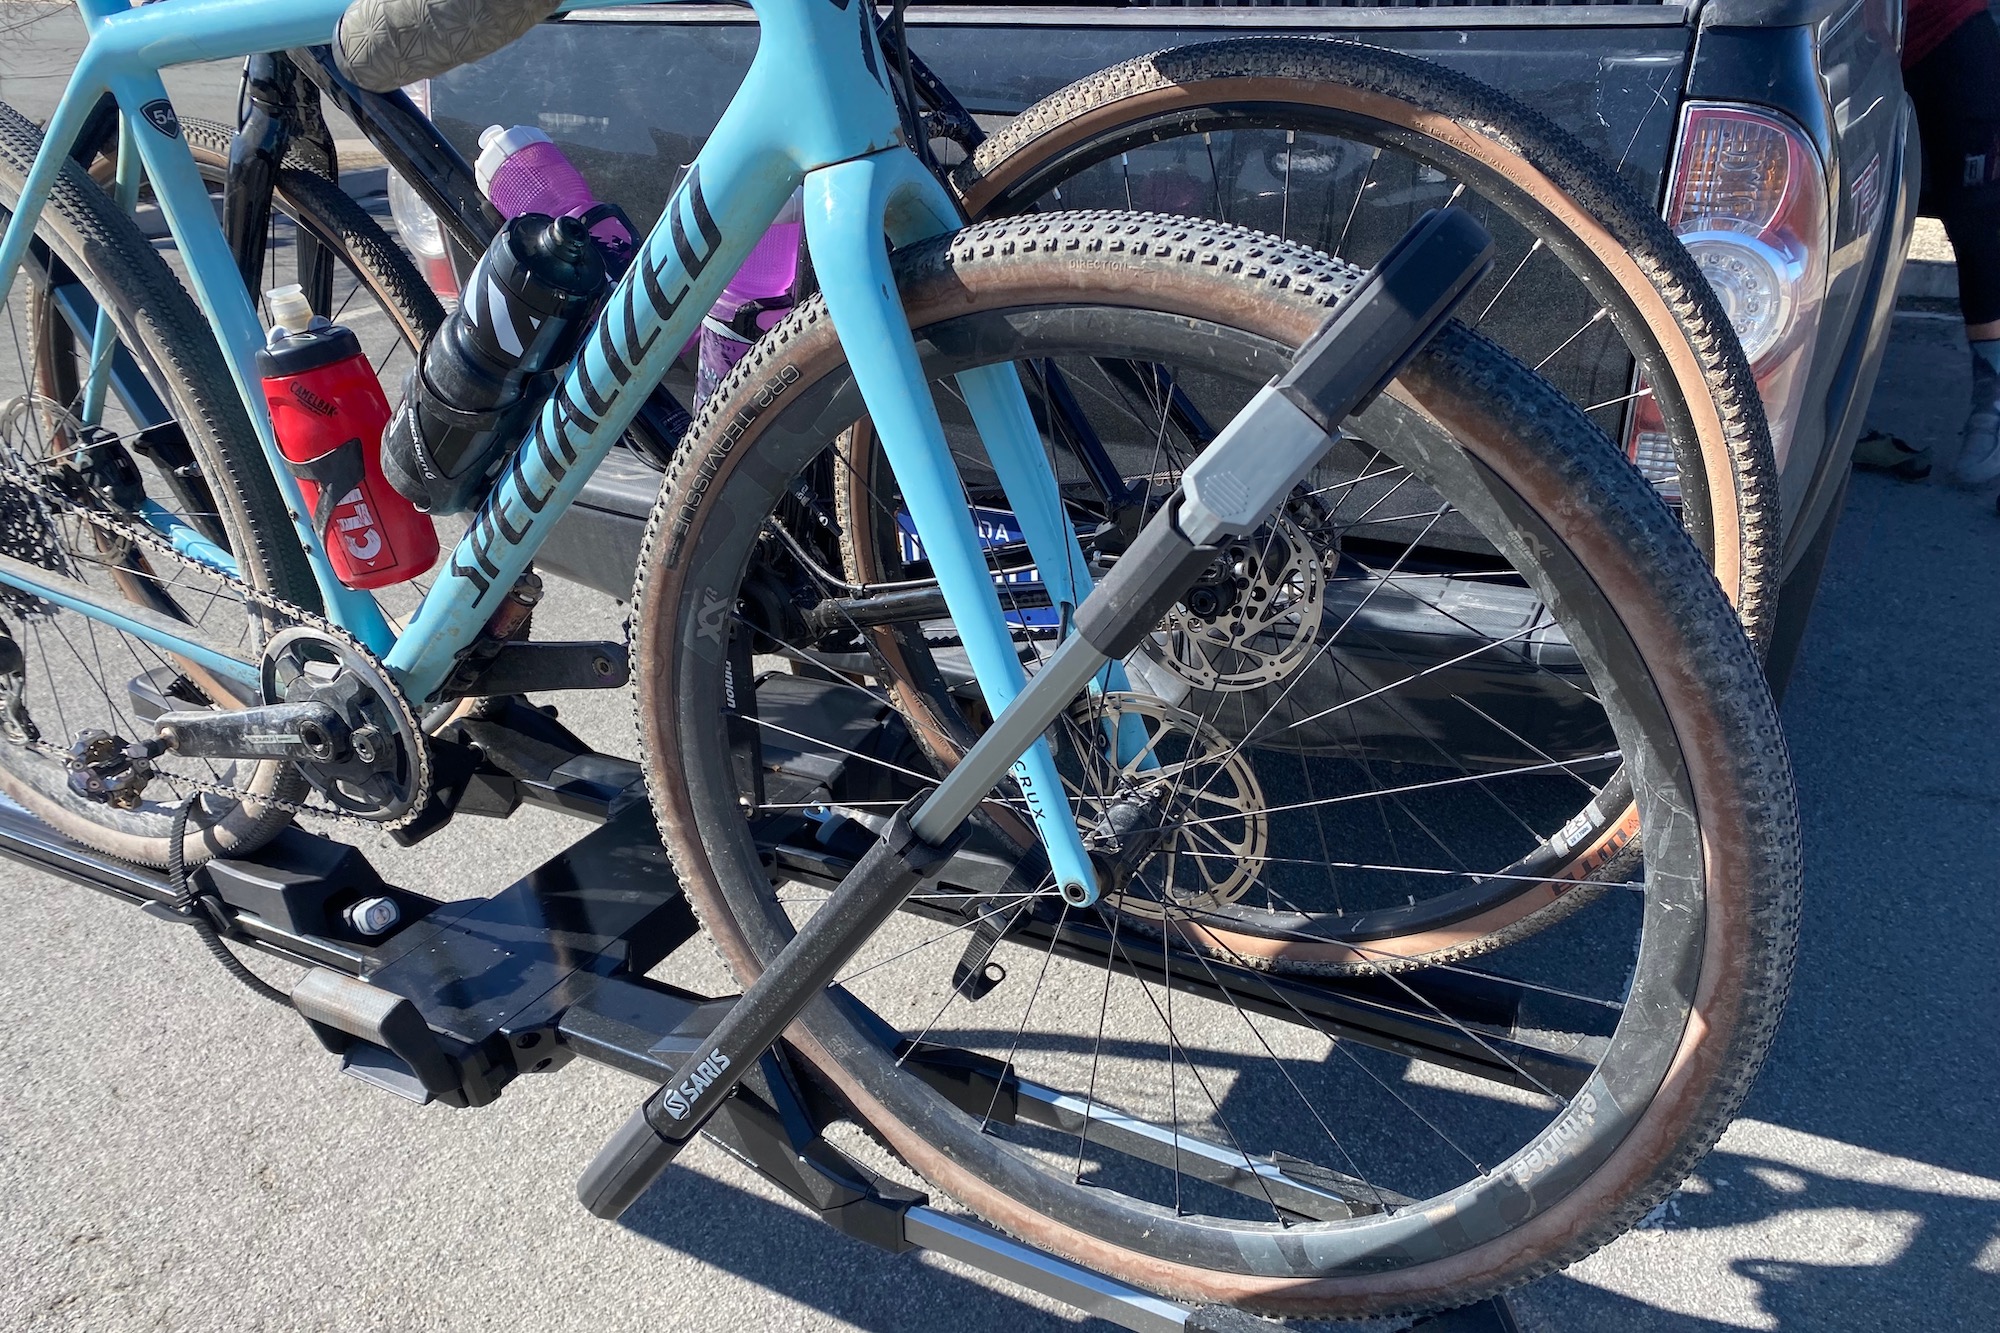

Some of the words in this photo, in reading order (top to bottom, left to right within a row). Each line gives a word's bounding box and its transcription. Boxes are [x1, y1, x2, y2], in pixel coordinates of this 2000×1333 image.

[153, 109, 176, 125] 54
[1069, 260, 1128, 272] DIRECTION
[290, 381, 336, 417] CAMELBAK
[451, 164, 722, 609] SPECIALIZED
[753, 364, 801, 408] GR2
[335, 487, 383, 560] CLI
[1014, 760, 1047, 820] CRUX
[680, 1047, 731, 1103] SARIS
